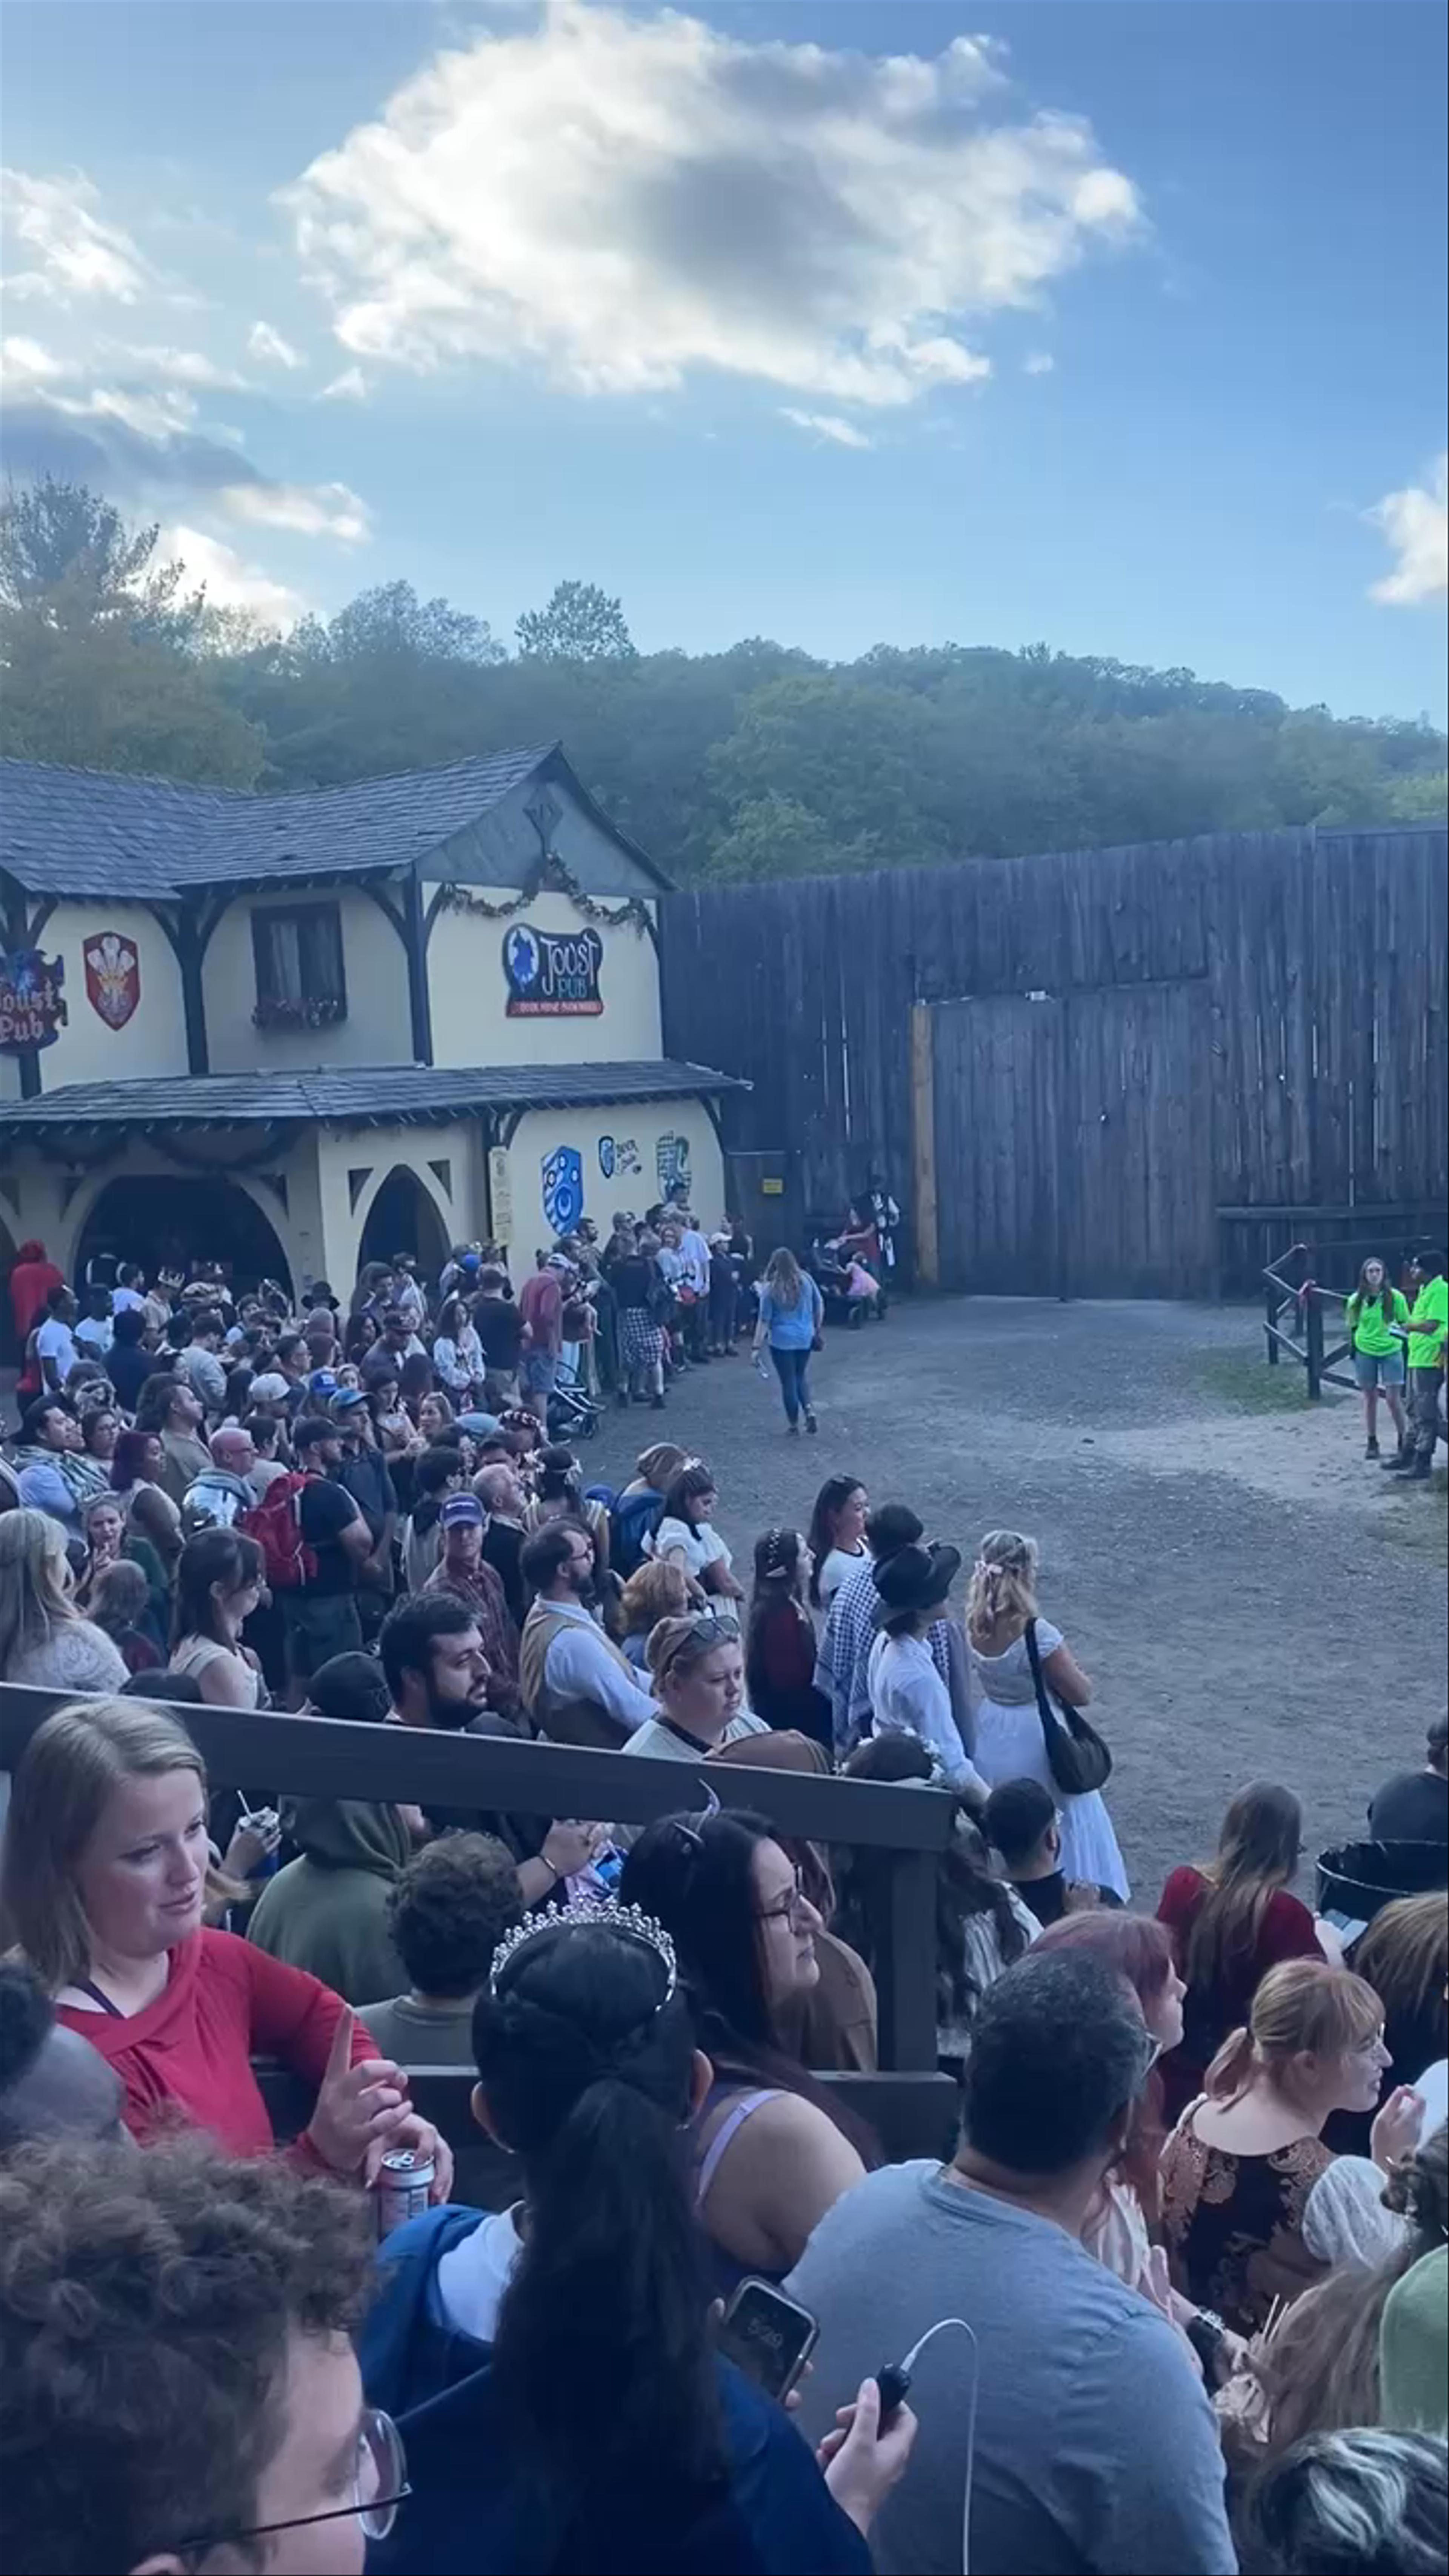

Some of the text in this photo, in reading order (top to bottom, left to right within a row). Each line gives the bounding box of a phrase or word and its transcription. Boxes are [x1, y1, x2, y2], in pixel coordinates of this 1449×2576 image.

[0, 978, 57, 1012] oust
[557, 978, 586, 998] PUB
[0, 1012, 45, 1042] Pub
